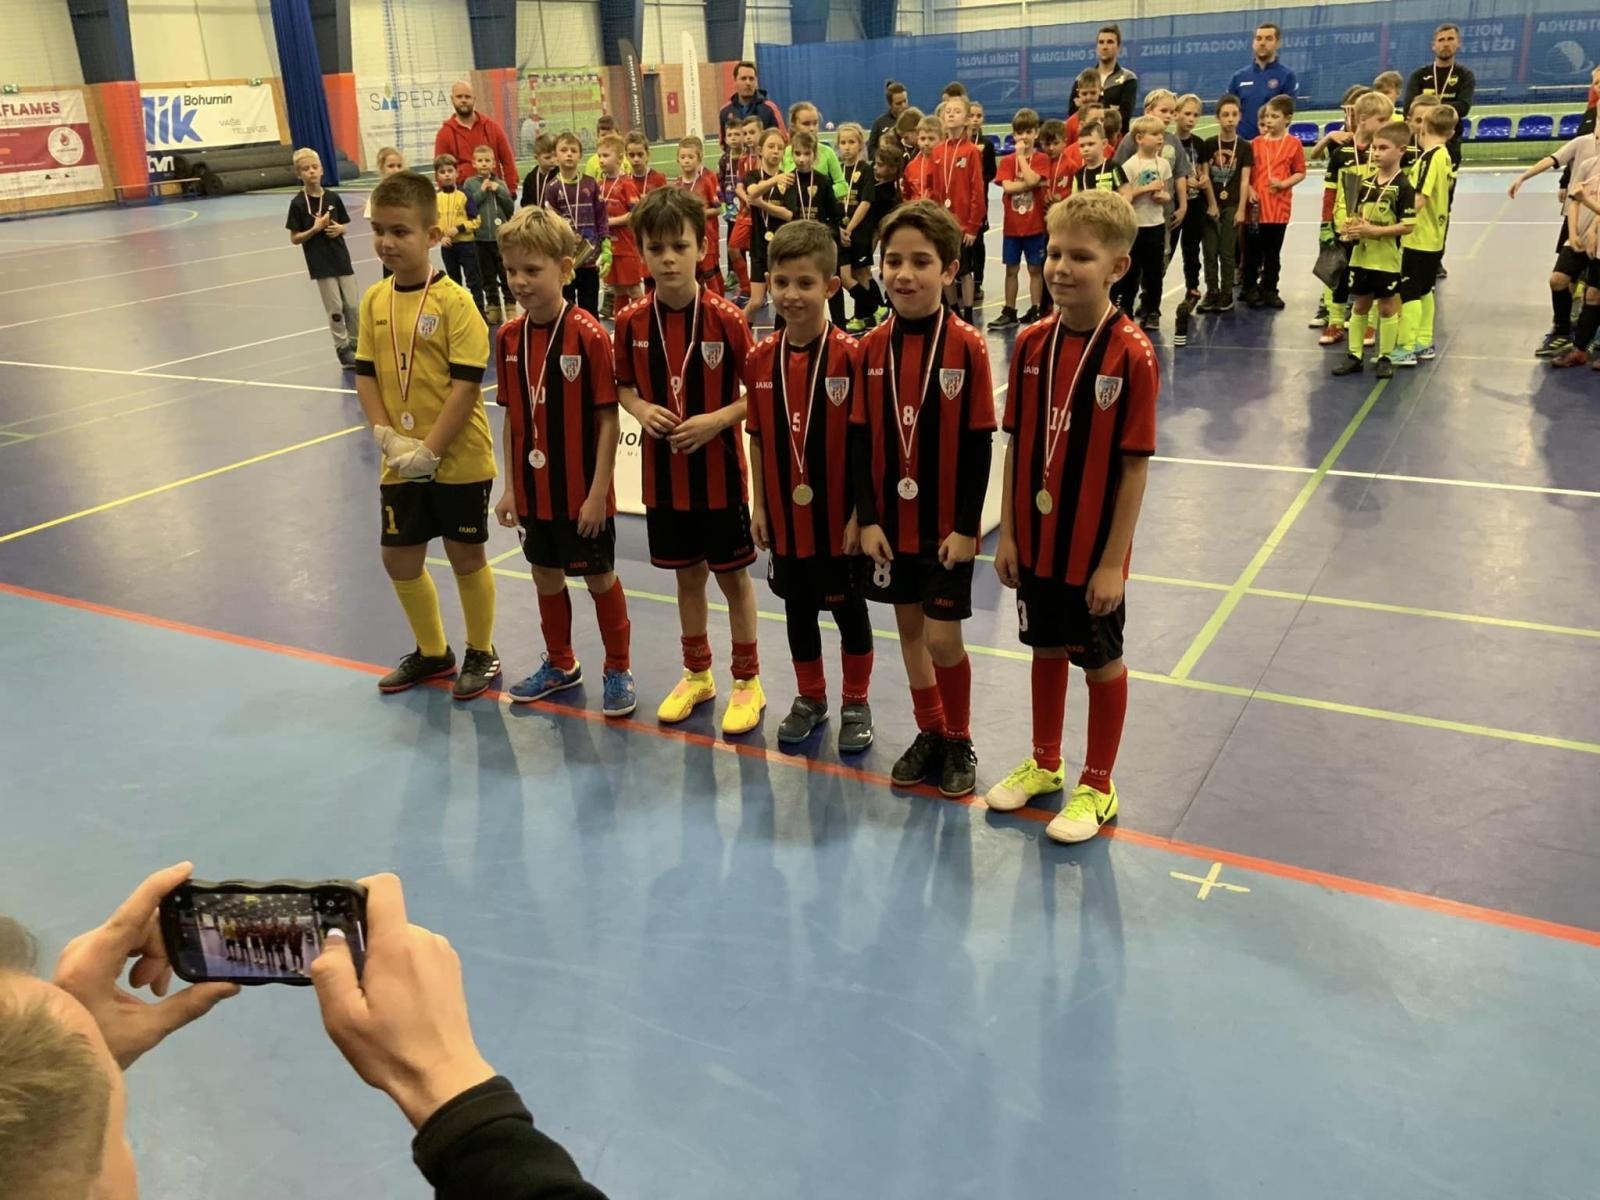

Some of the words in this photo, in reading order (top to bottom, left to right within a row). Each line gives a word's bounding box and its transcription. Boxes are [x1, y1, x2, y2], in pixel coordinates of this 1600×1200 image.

[1185, 39, 1249, 54] STADION
[0, 102, 60, 117] FLAMES
[401, 352, 408, 370] 1
[755, 382, 773, 390] JAKO
[792, 412, 801, 432] 5
[902, 405, 914, 426] 8
[385, 505, 399, 534] 1
[873, 562, 892, 589] 8
[1083, 765, 1107, 776] AKO
